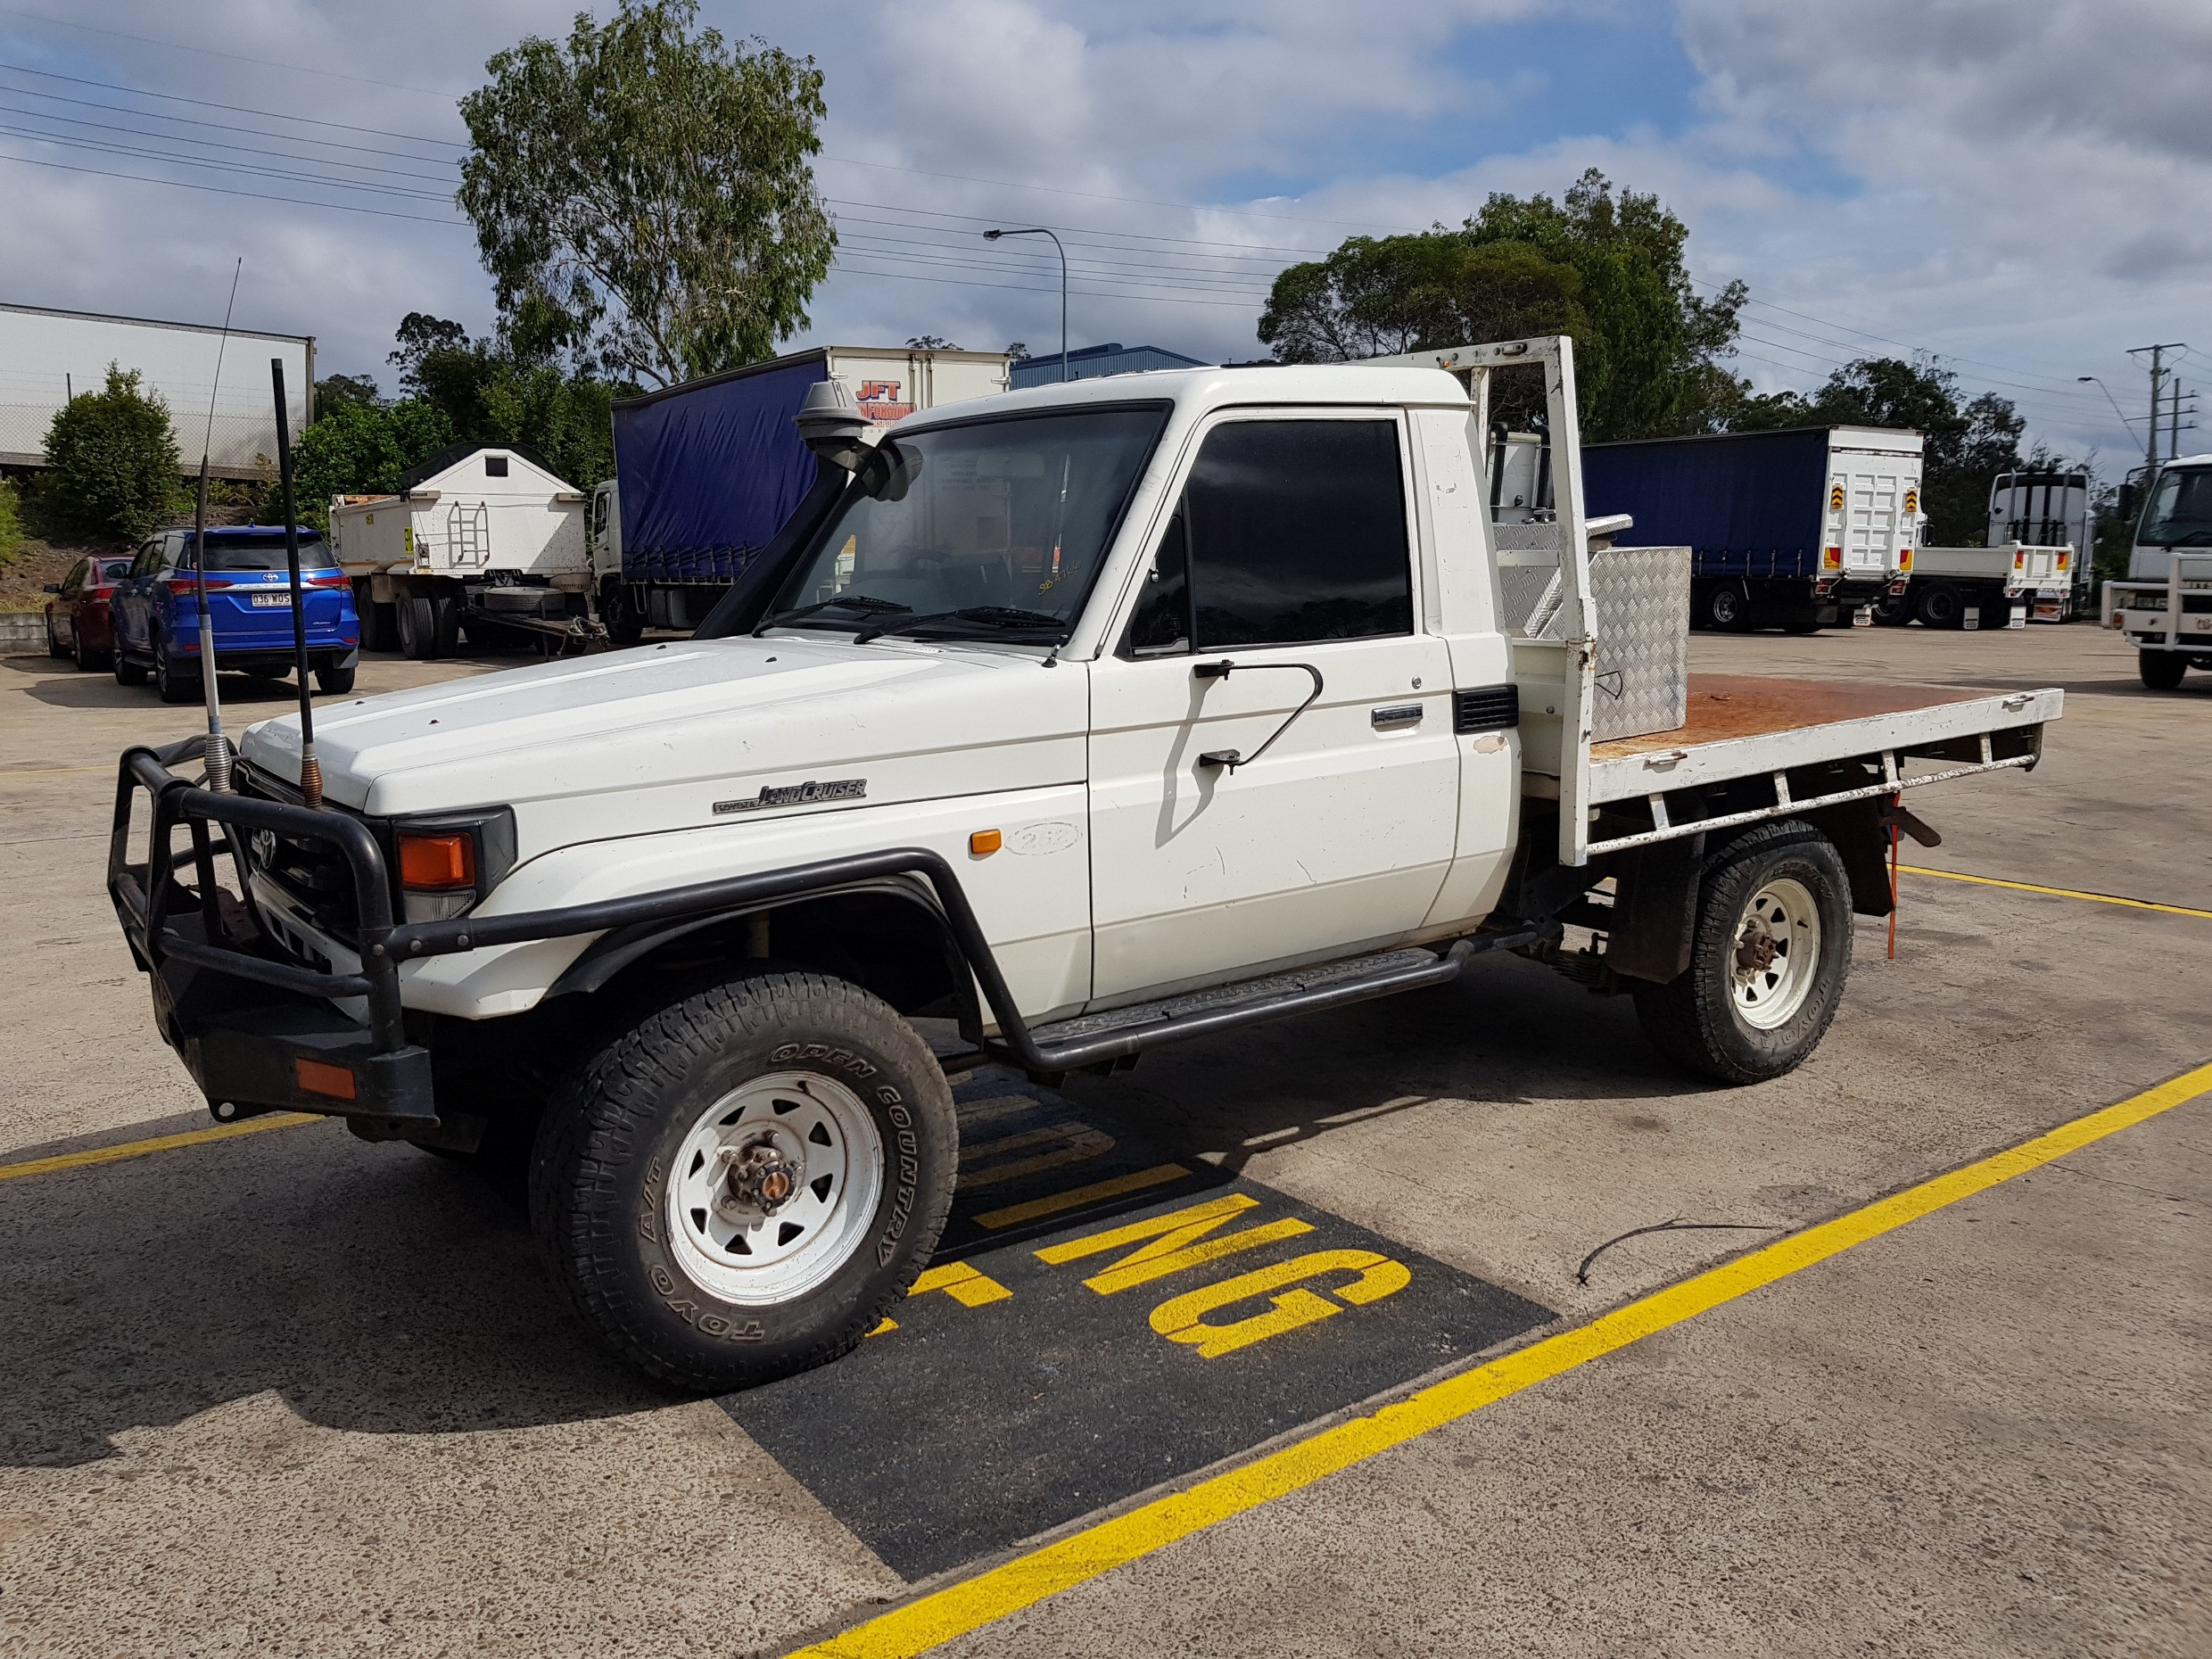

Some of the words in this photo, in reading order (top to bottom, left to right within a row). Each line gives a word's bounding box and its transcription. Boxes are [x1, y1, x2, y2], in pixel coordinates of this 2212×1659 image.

[856, 381, 901, 401] JFT
[868, 402, 915, 420] FORGION
[252, 594, 269, 604] 036
[715, 800, 756, 812] TOYOTA
[770, 1042, 878, 1079] OPEN
[875, 1085, 920, 1269] COUNTRY
[639, 1156, 664, 1243] A/T
[650, 1263, 764, 1342] TOYO
